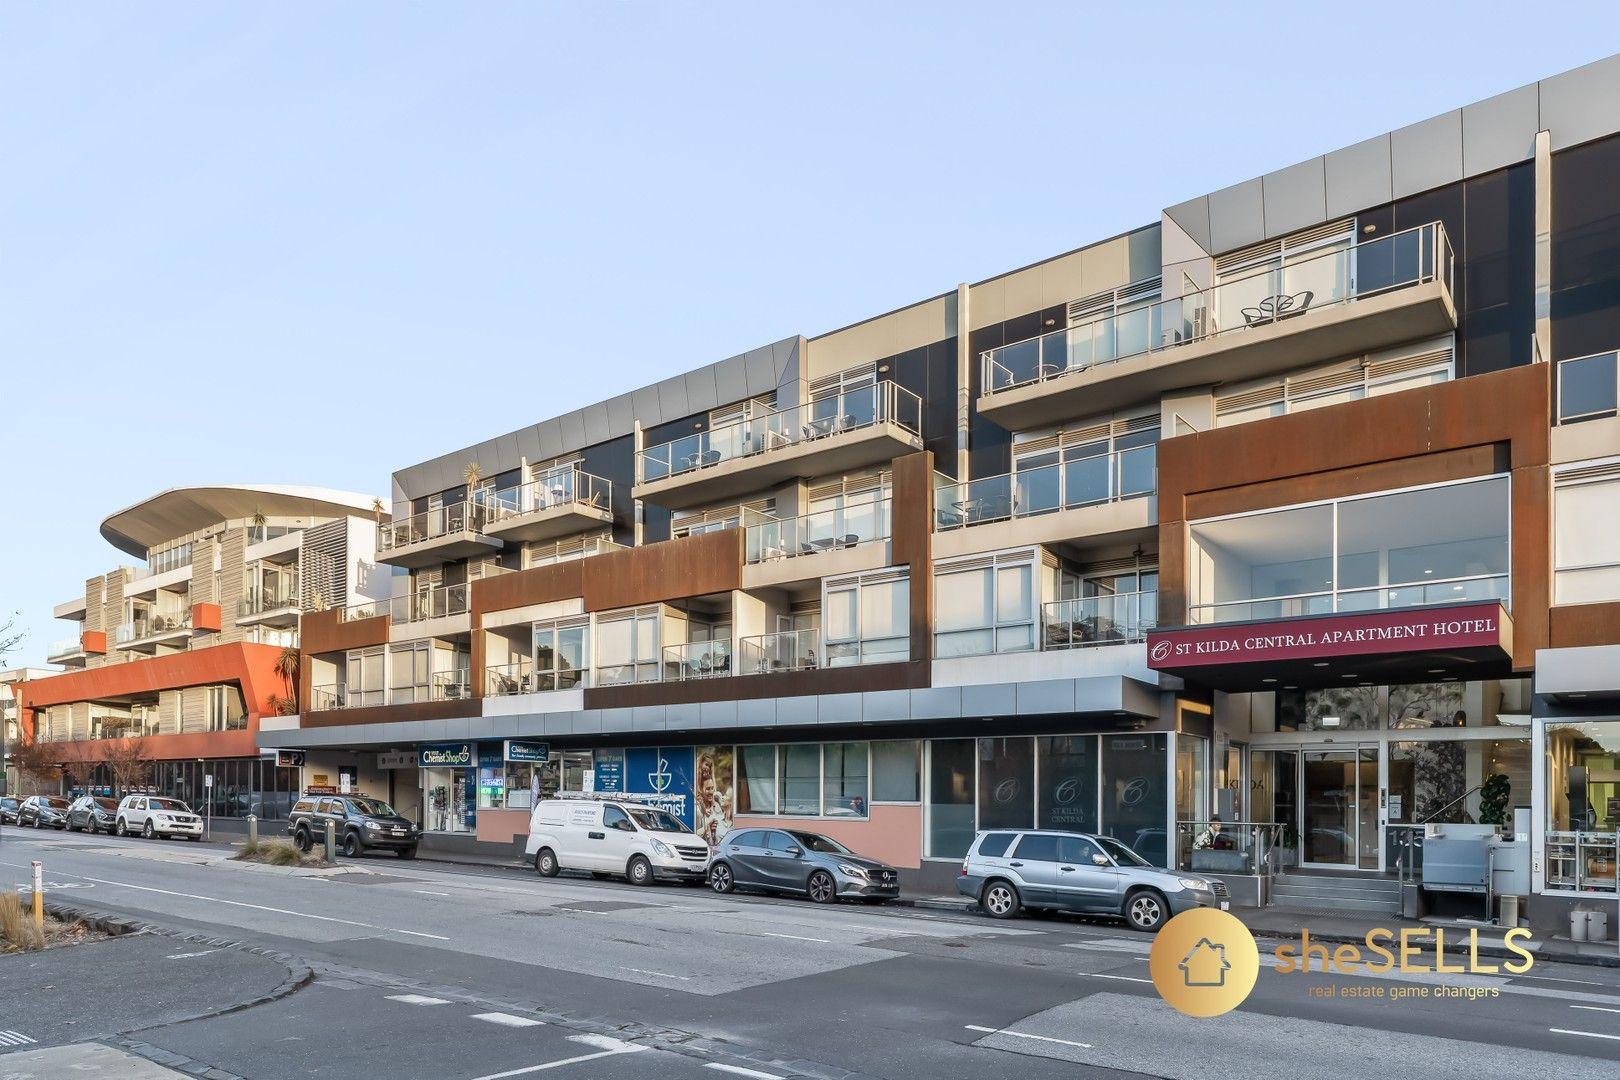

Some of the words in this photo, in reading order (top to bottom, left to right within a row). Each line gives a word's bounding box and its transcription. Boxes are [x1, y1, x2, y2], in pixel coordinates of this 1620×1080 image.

[1175, 643, 1192, 655] ST
[1196, 640, 1240, 654] KILDA
[1244, 633, 1316, 650] CENTRAL
[1321, 624, 1428, 643] APARTMENT
[1433, 619, 1496, 636] HOTEL
[1229, 779, 1264, 790] KIDA
